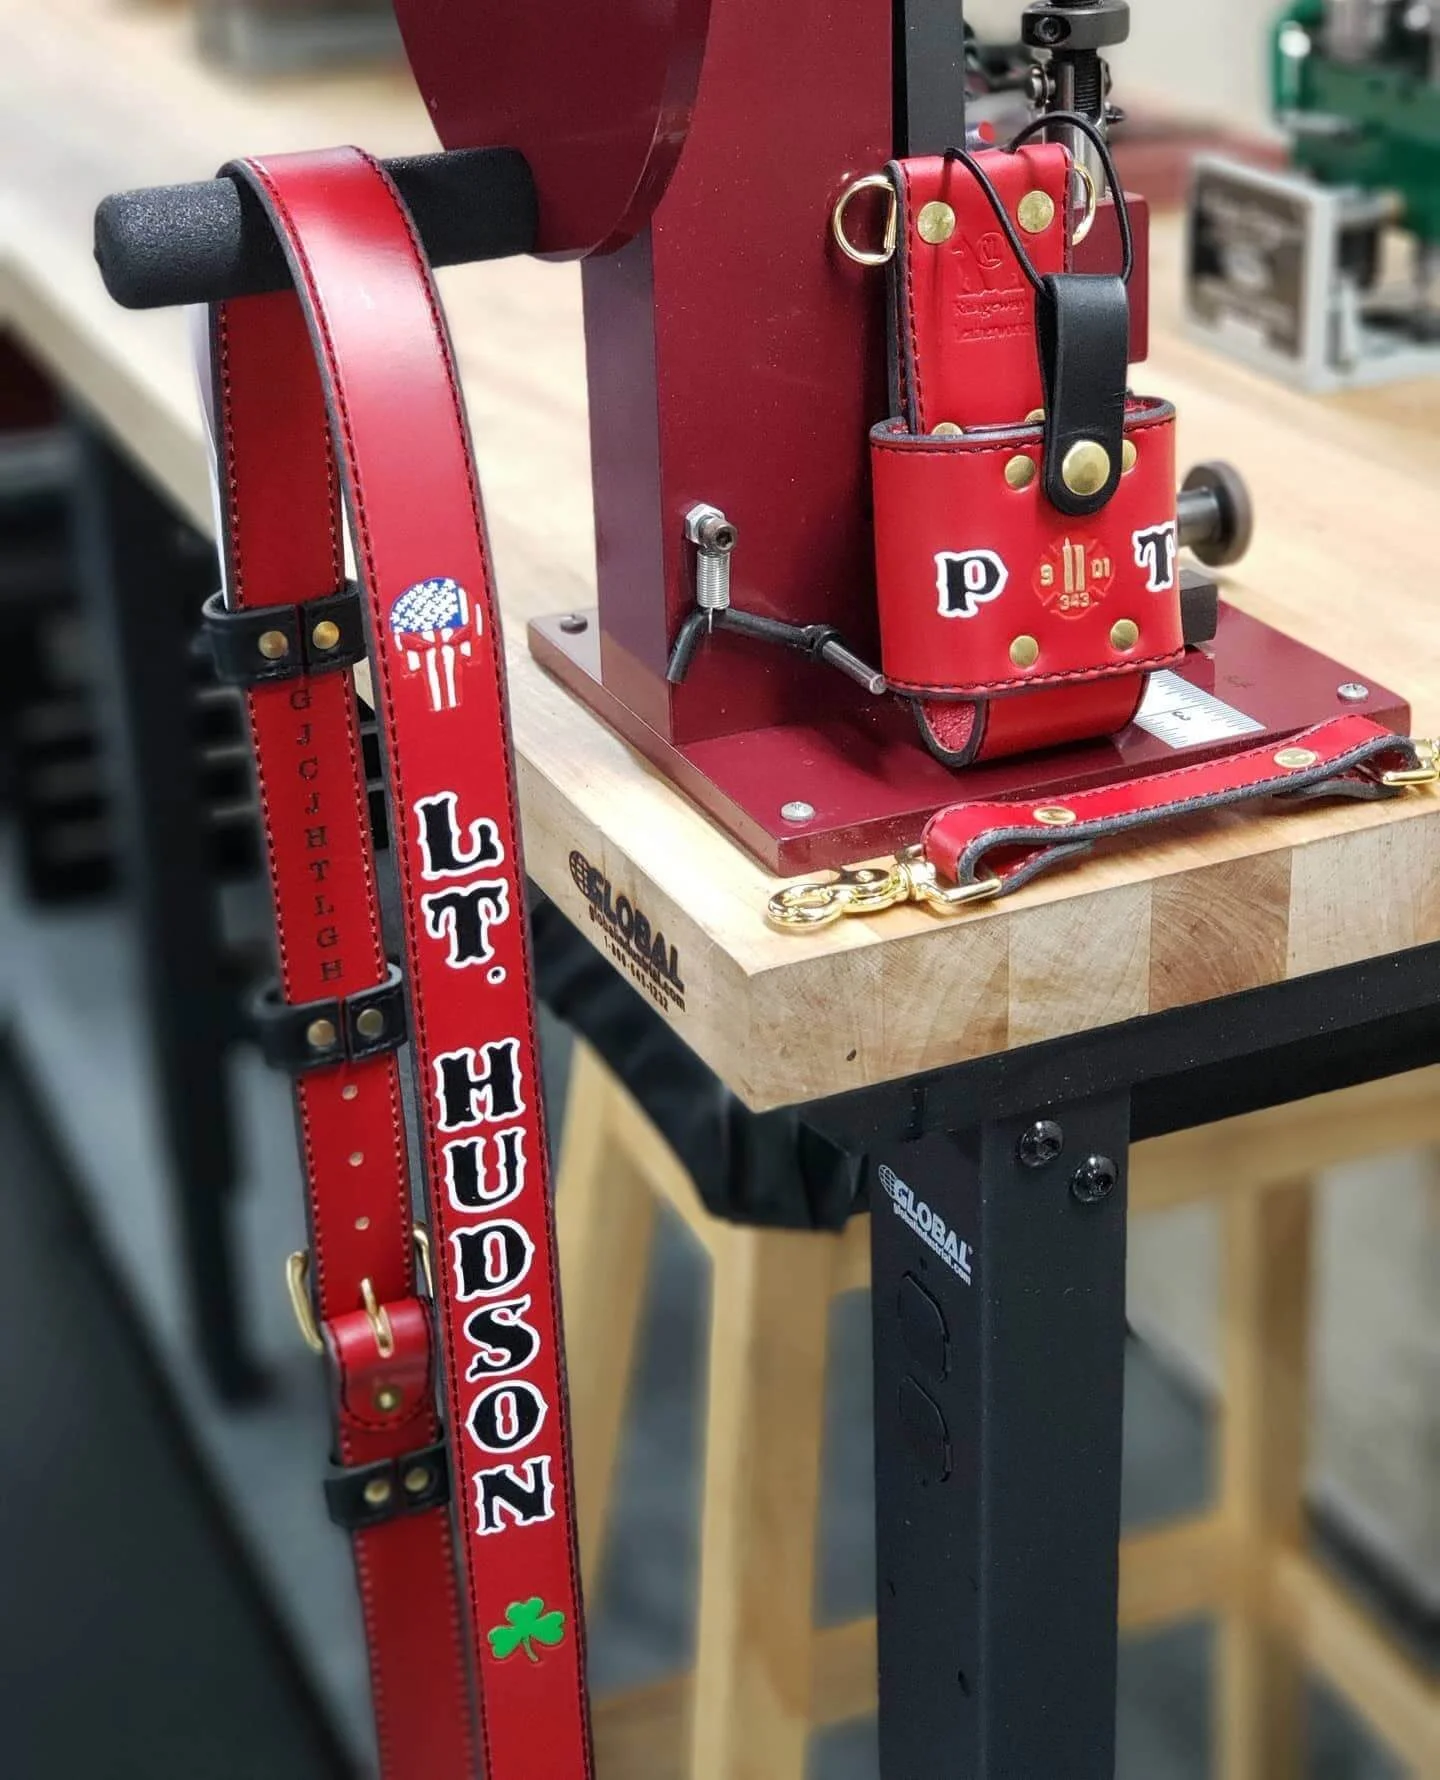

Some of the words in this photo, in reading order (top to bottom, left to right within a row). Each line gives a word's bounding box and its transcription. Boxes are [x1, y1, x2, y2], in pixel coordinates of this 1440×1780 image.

[934, 549, 1009, 618] P
[1040, 564, 1054, 587] 9
[1132, 520, 1177, 592] T
[1060, 592, 1090, 611] 343
[413, 792, 508, 985] LT.
[587, 866, 685, 995] GLOBAL
[893, 1179, 972, 1274] GLOBAL
[433, 1037, 555, 1536] HUDSON
